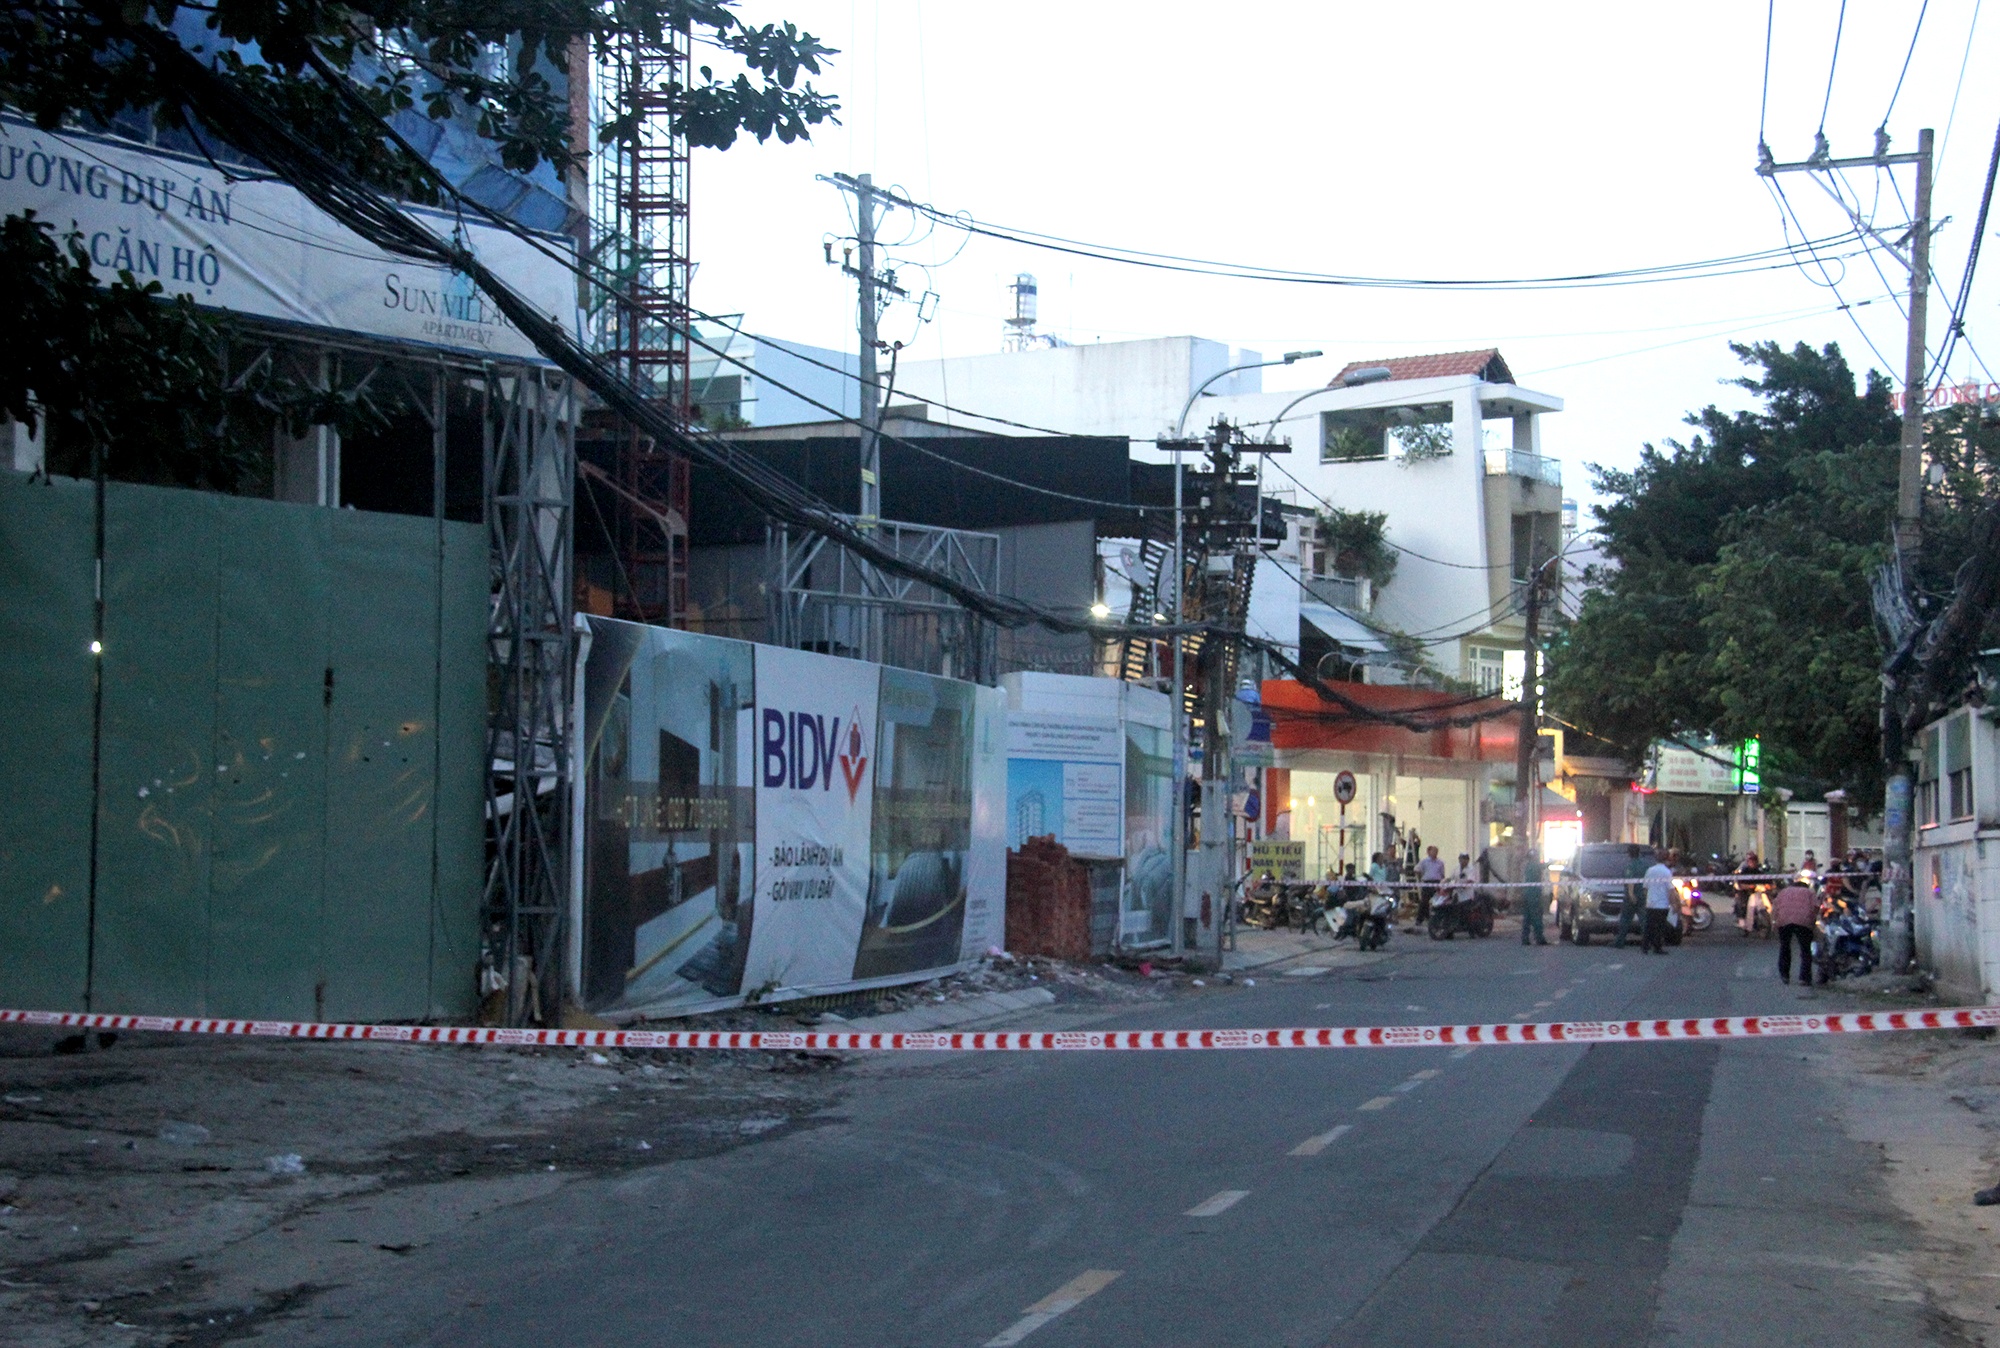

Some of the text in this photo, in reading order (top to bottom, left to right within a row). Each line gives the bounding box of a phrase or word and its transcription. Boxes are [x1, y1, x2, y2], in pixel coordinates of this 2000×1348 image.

[120, 171, 176, 220] DỰ
[185, 177, 231, 225] ÁN
[90, 226, 220, 296] CĂN HỘ
[763, 707, 840, 791] BIDV
